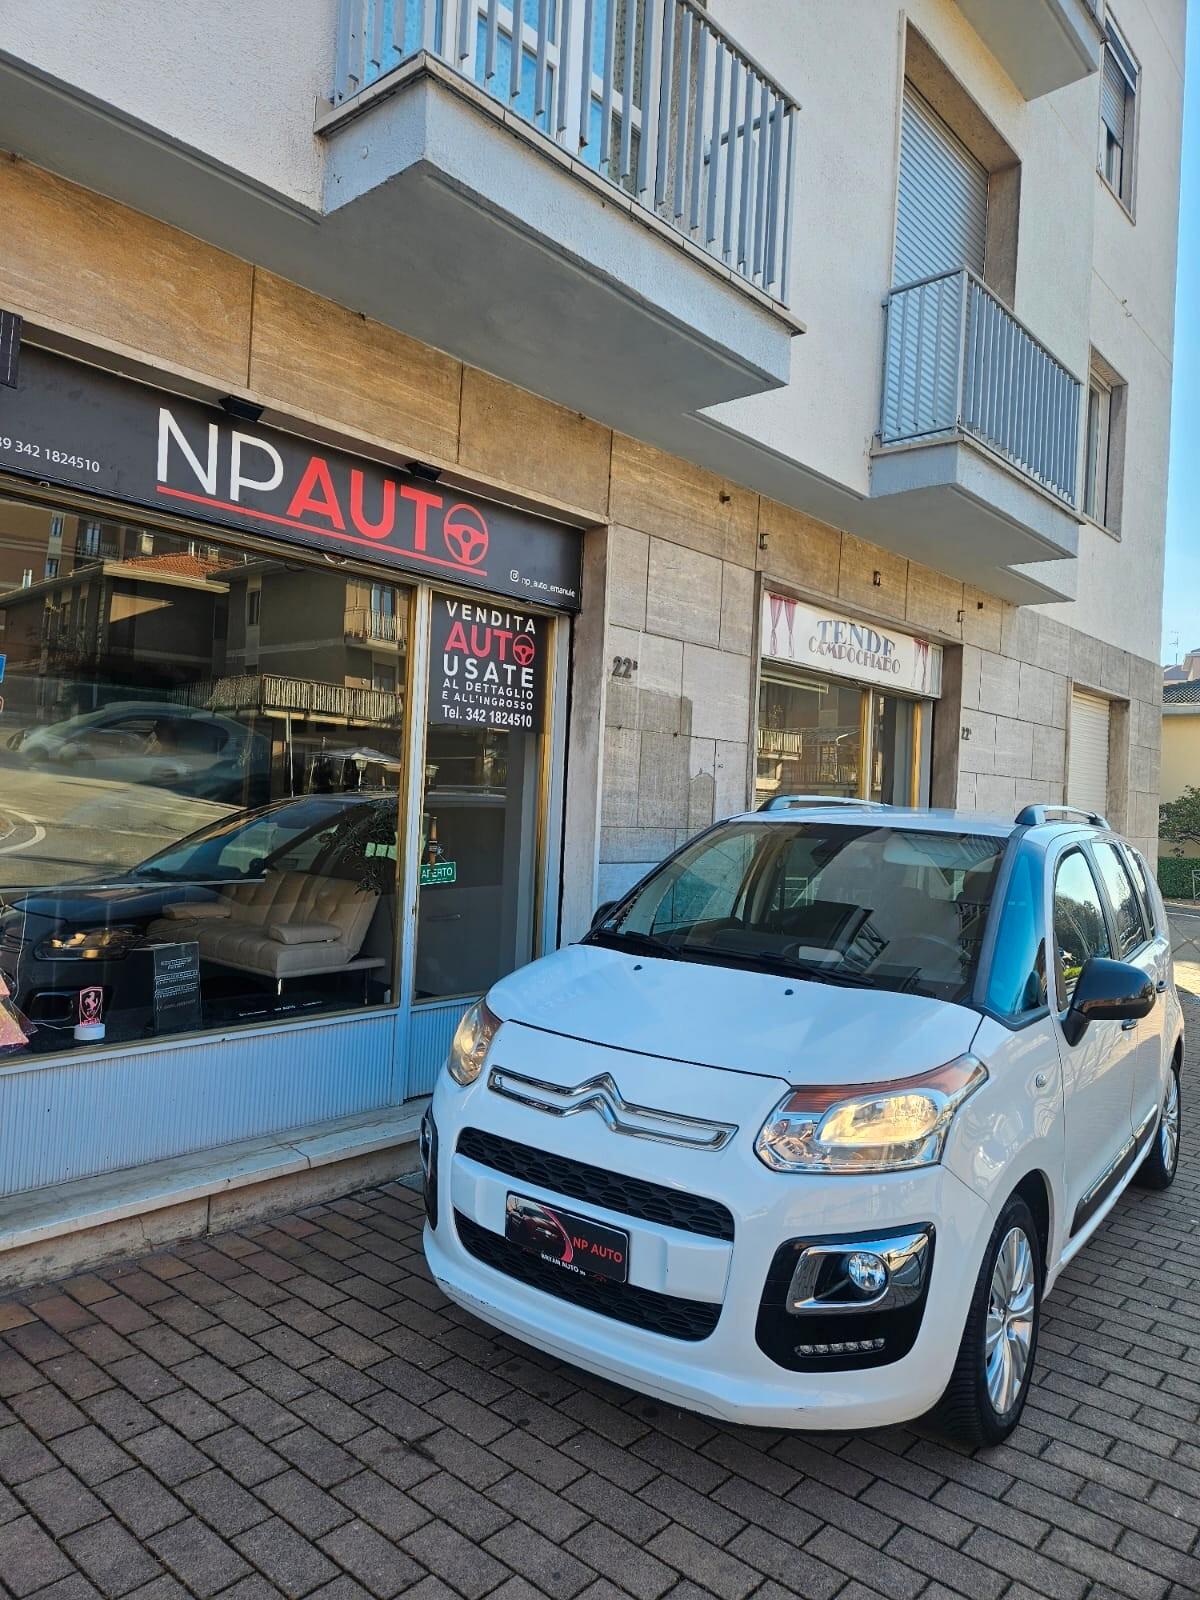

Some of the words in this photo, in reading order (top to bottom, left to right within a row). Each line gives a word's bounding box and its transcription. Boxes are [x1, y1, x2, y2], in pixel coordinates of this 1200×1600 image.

[15, 440, 41, 458] 342
[45, 449, 100, 473] 1824510
[446, 600, 536, 634] VENDITA
[443, 653, 534, 688] USATE
[442, 678, 459, 690] AL
[466, 681, 534, 700] DETTAGLIO
[442, 691, 449, 700] E
[453, 692, 533, 711] ALL'INGROSSO
[442, 704, 463, 719] Tel.
[465, 708, 487, 723] 342
[489, 710, 532, 728] 1824510
[573, 1236, 589, 1250] NP
[590, 1243, 623, 1264] AUTO
